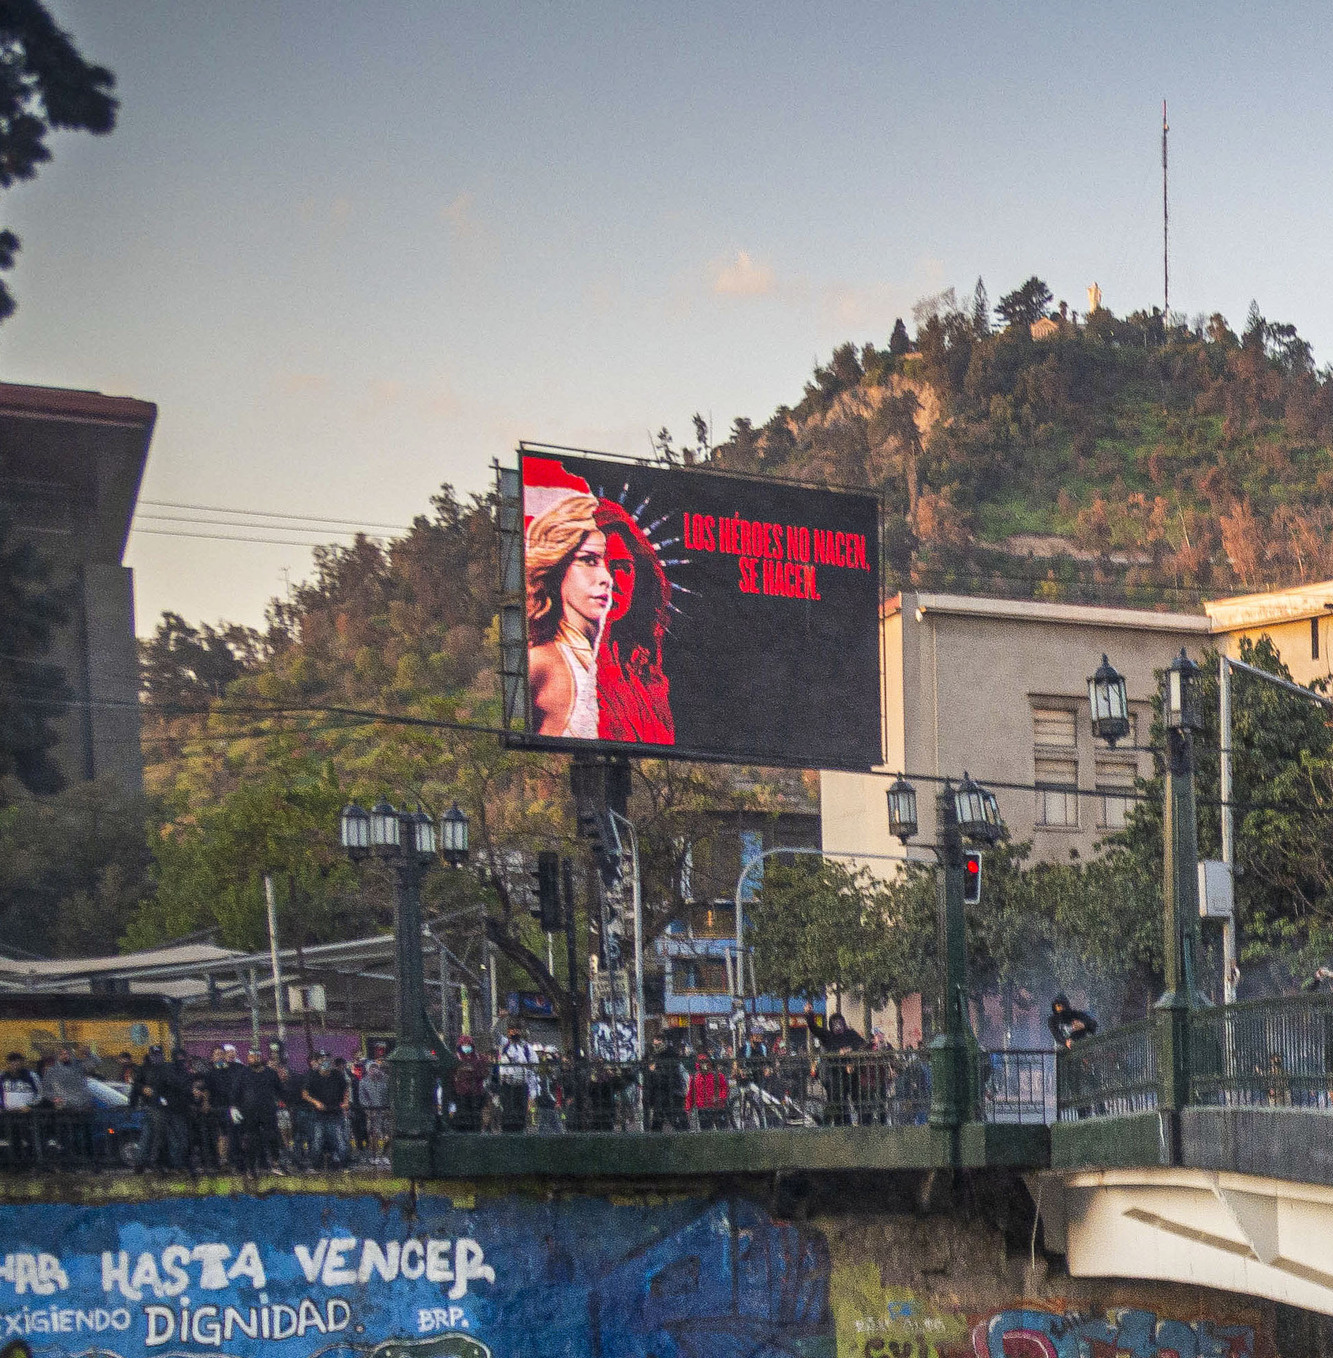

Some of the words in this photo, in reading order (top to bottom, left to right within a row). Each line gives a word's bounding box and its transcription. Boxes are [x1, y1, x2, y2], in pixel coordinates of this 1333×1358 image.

[683, 512, 716, 552] LOS
[719, 511, 784, 560] HÉROES
[787, 525, 810, 563] NO
[814, 529, 871, 572] NACEN,
[739, 556, 760, 594] SE
[763, 559, 822, 601] HACEN.
[101, 1241, 266, 1300] HASTA
[294, 1237, 495, 1299] VENCER
